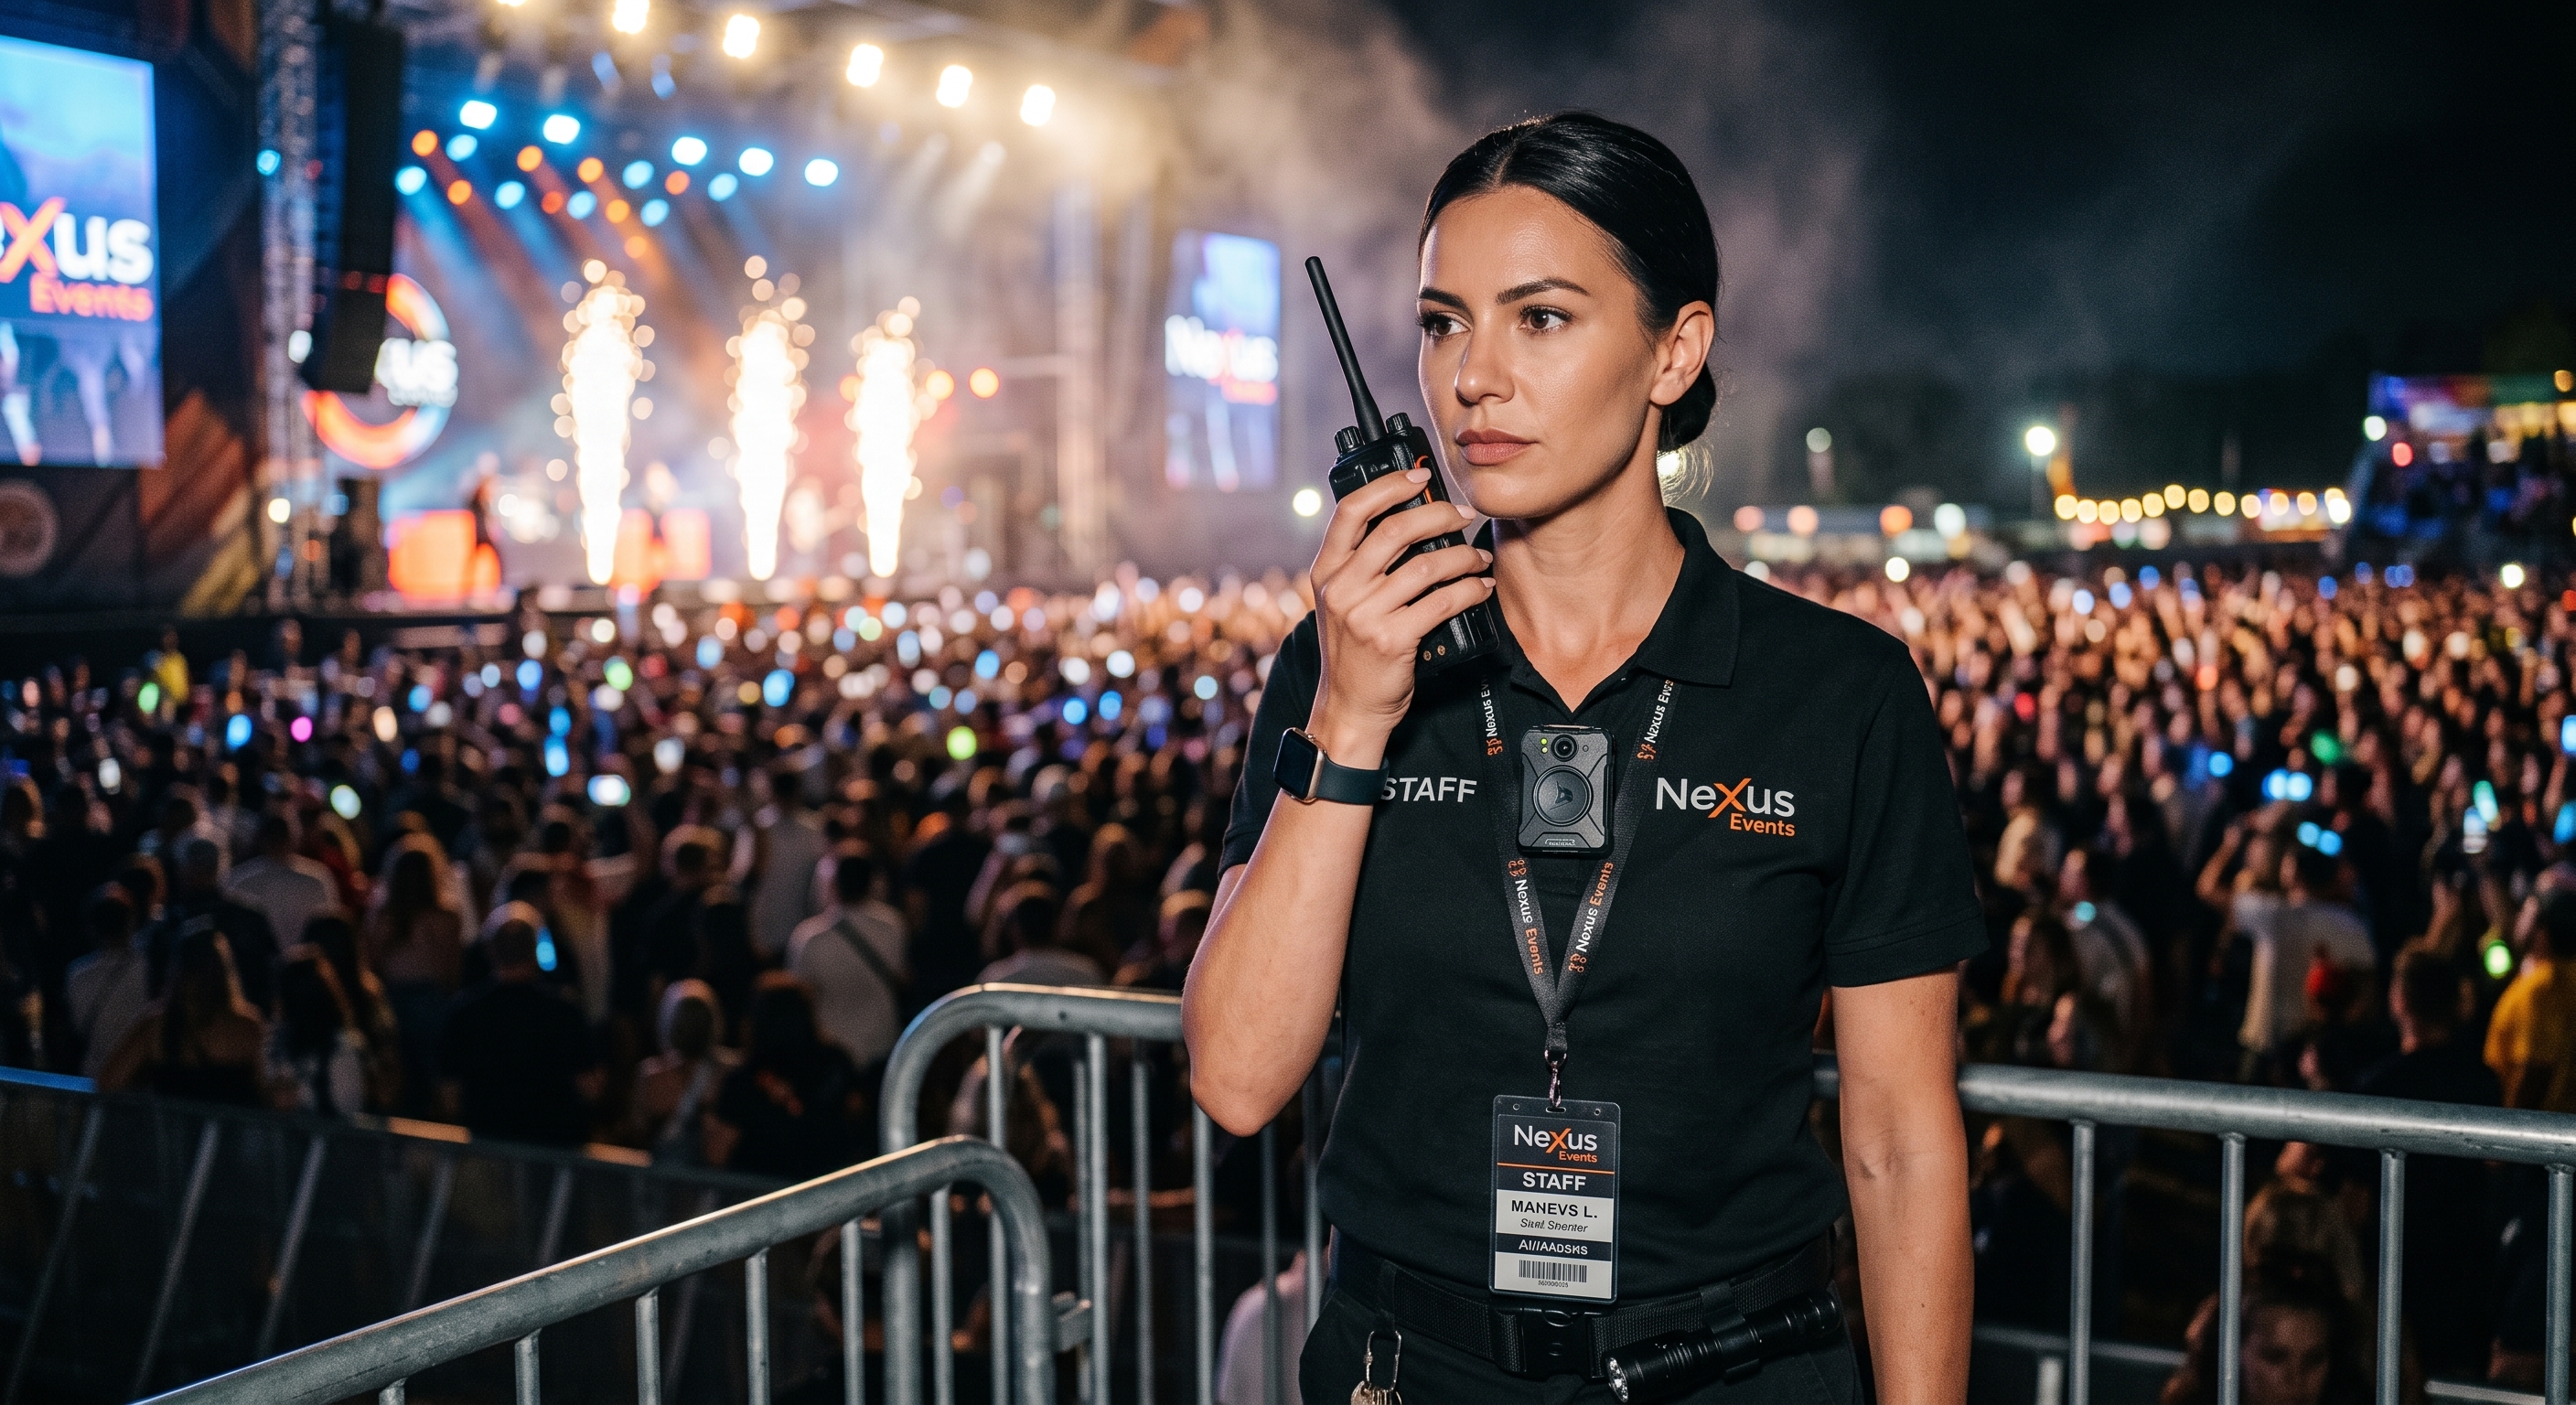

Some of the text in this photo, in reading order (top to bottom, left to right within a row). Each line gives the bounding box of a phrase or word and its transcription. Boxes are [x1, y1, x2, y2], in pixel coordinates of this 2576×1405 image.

[1380, 777, 1477, 803] STAFF
[1730, 812, 1796, 837] Events
[1559, 1151, 1598, 1163] Events
[1522, 1172, 1586, 1191] STAFF
[1511, 1200, 1598, 1218] MANEVS L.
